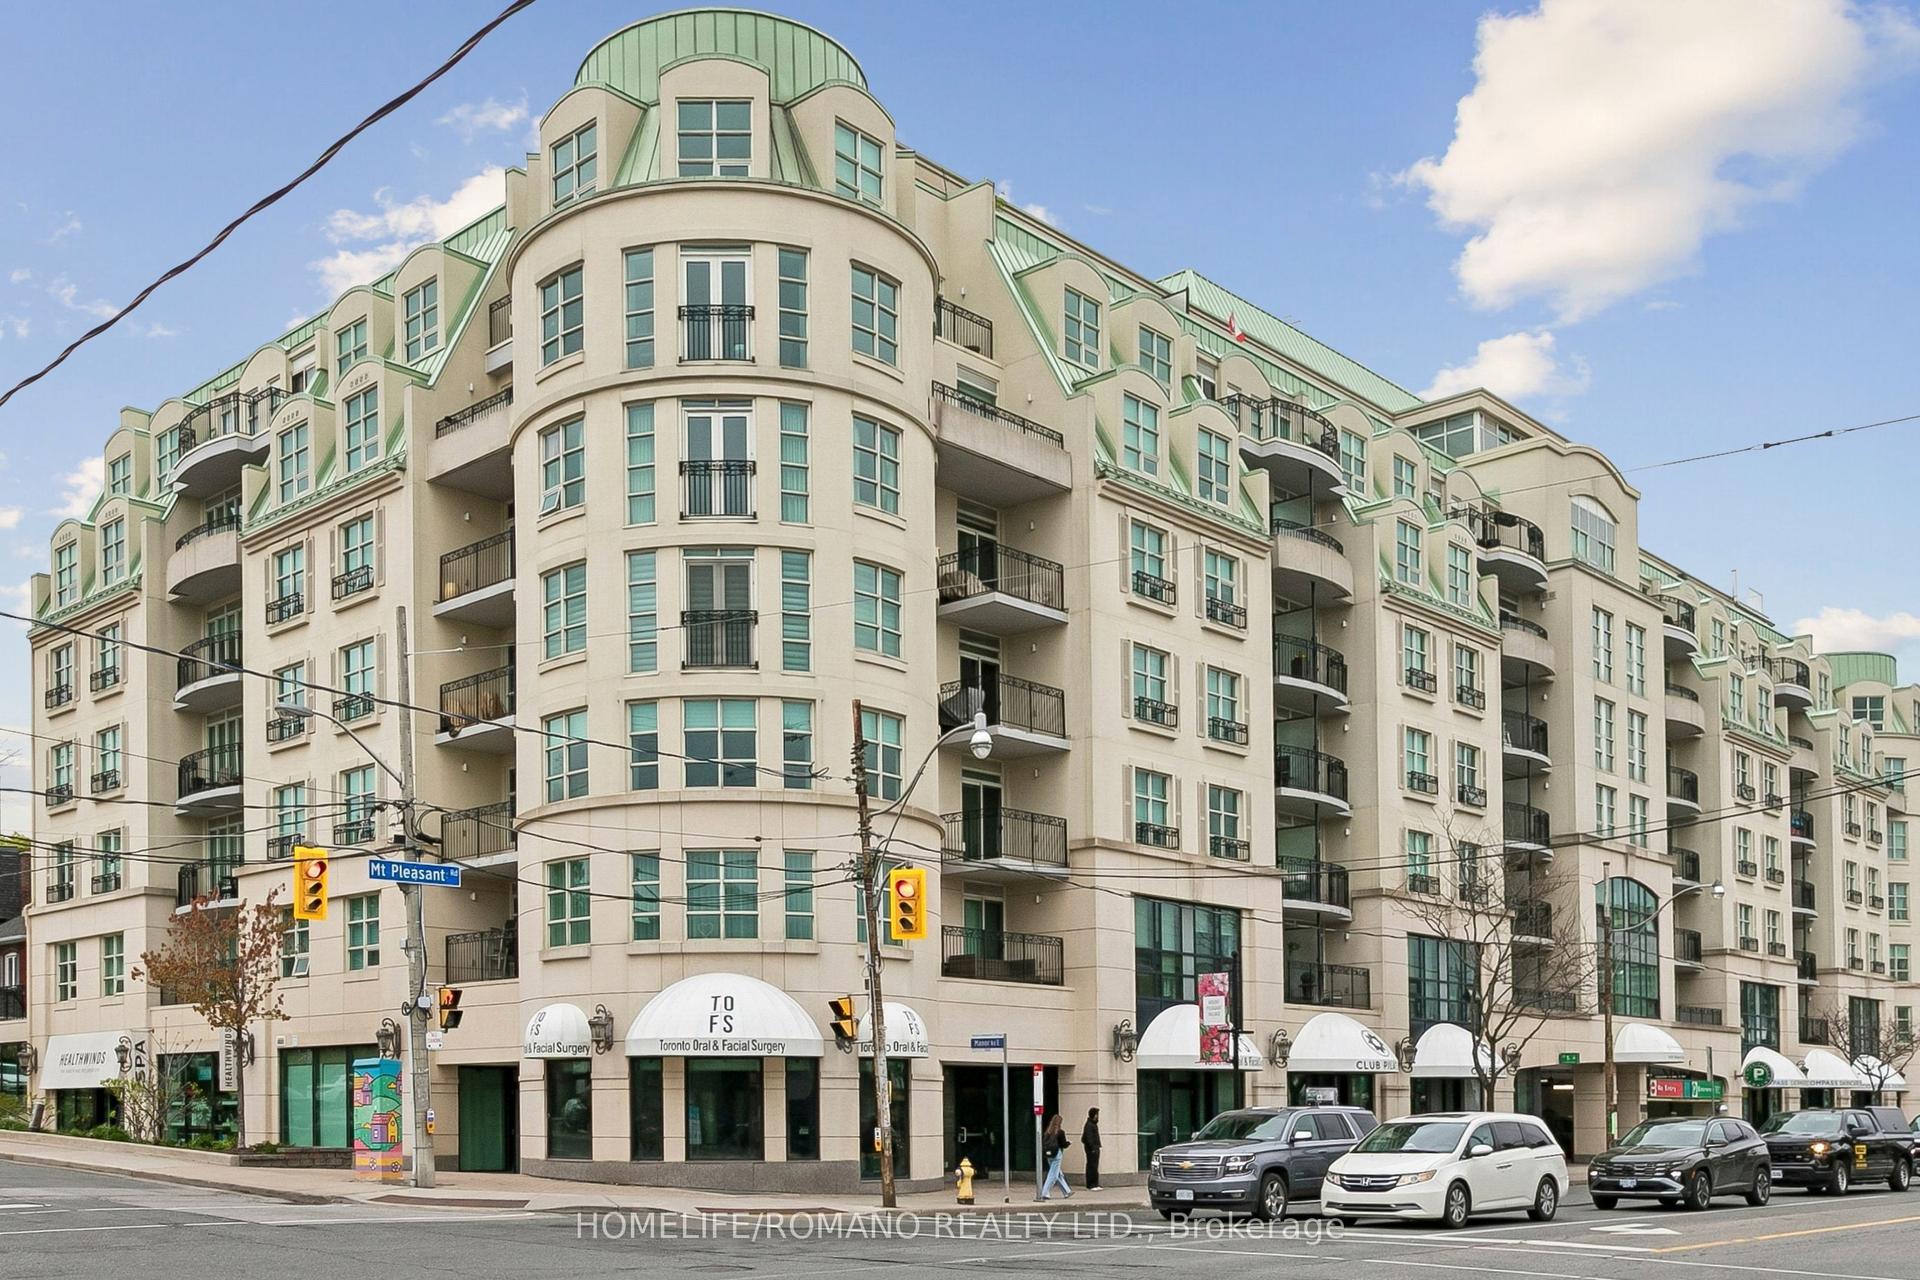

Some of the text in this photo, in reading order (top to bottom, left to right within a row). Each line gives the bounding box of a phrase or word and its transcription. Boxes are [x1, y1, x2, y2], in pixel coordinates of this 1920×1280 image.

[370, 862, 386, 877] Mt
[391, 864, 446, 882] Pleasant
[710, 995, 734, 1012] TO
[709, 1014, 734, 1034] FS
[533, 1042, 556, 1054] Facial
[556, 1041, 590, 1056] Surgery
[660, 1039, 786, 1054] Toronto Oral & Facial Surgery
[893, 1041, 910, 1053] Oral
[59, 1051, 106, 1066] HEALTHWINDS
[224, 1027, 233, 1088] HEALTHWINDS
[1356, 1060, 1381, 1070] CLUB
[1753, 1067, 1765, 1081] P
